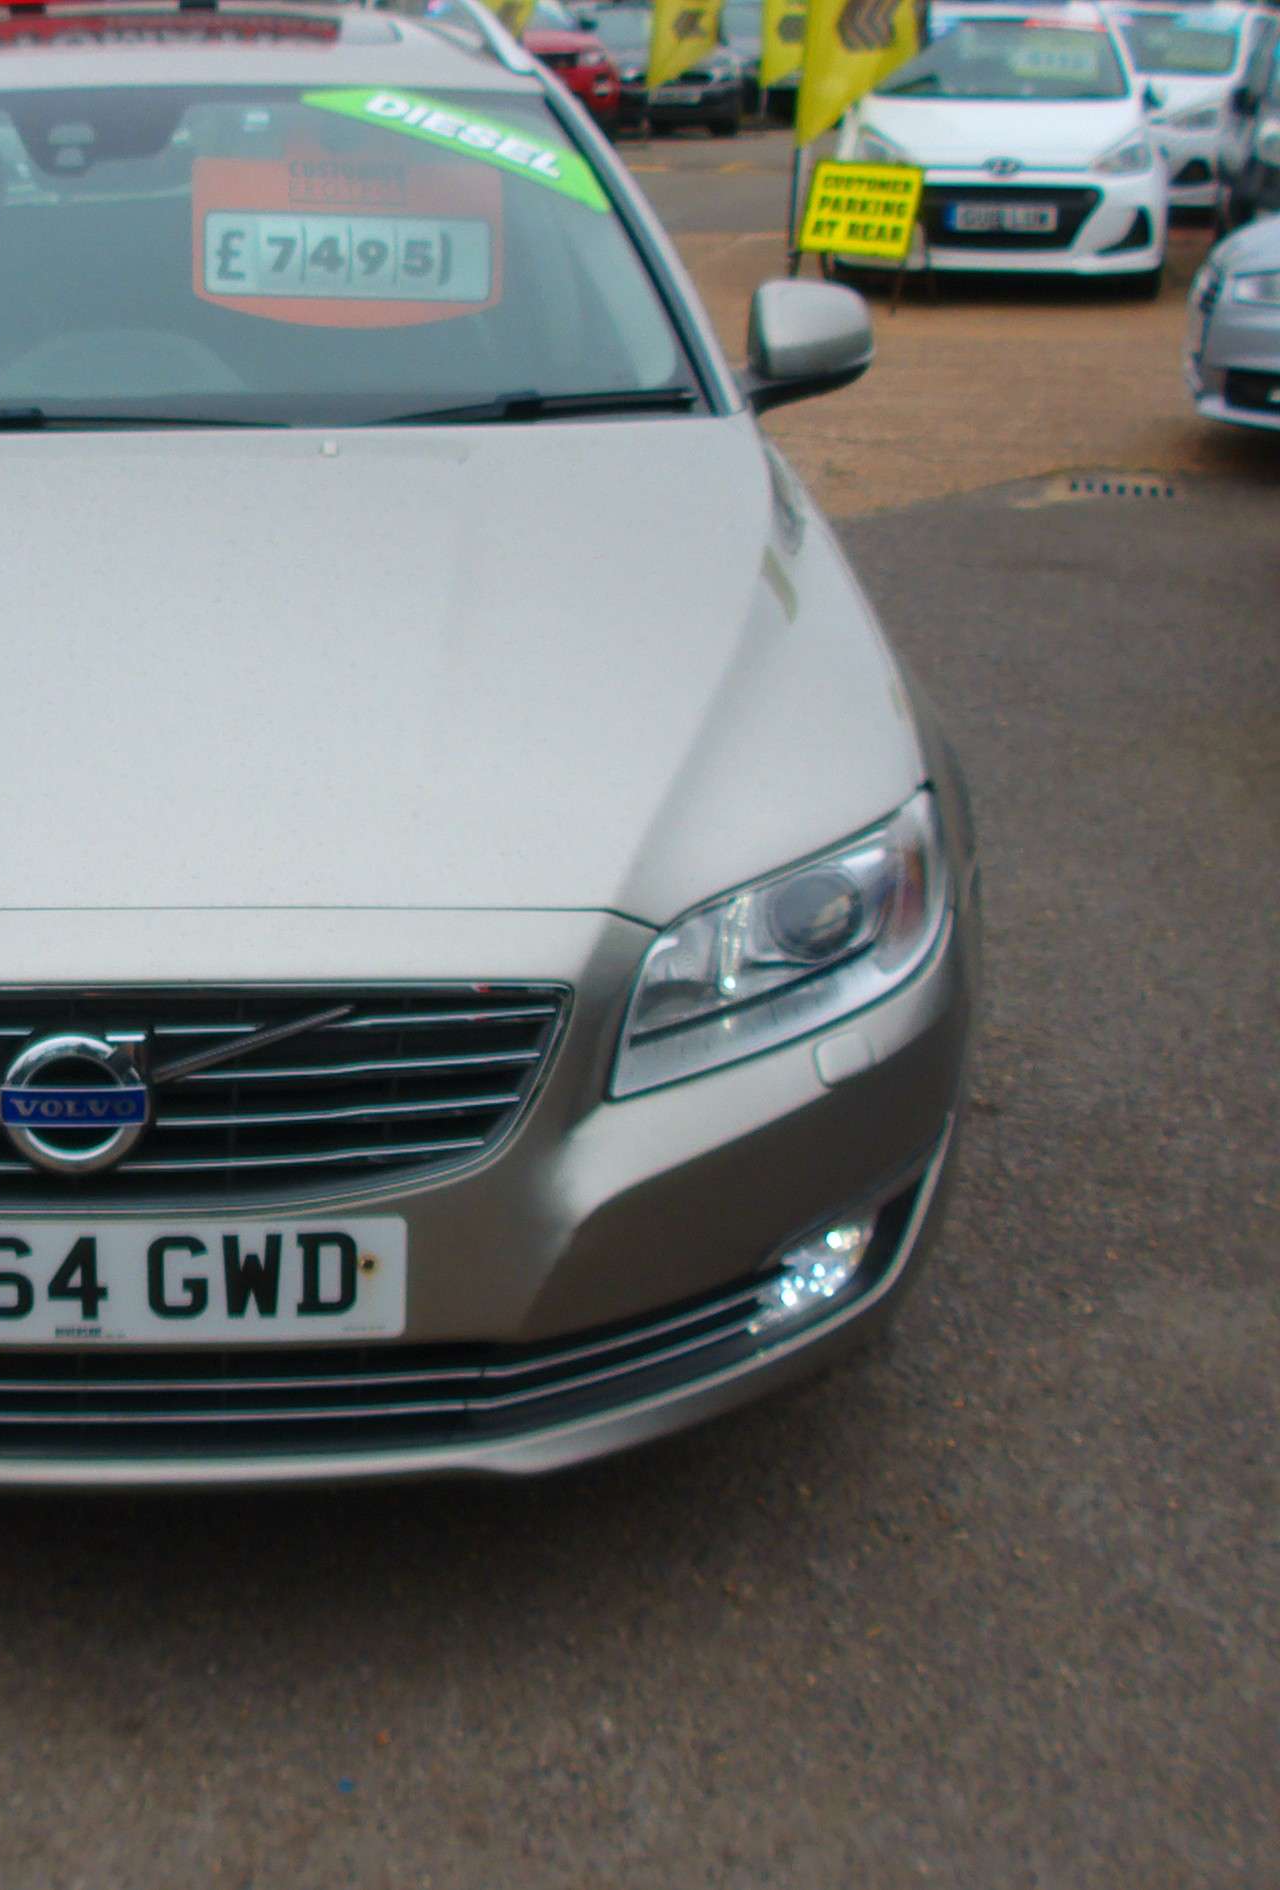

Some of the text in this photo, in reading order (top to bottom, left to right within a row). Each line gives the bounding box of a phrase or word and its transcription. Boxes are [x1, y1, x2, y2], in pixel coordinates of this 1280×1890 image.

[364, 92, 561, 179] DIESEL
[822, 175, 913, 193] CUSTOMER
[818, 196, 908, 219] PARKING
[812, 219, 904, 243] AT REAR
[9, 1098, 137, 1118] VOLVO
[146, 1231, 358, 1321] GWD
